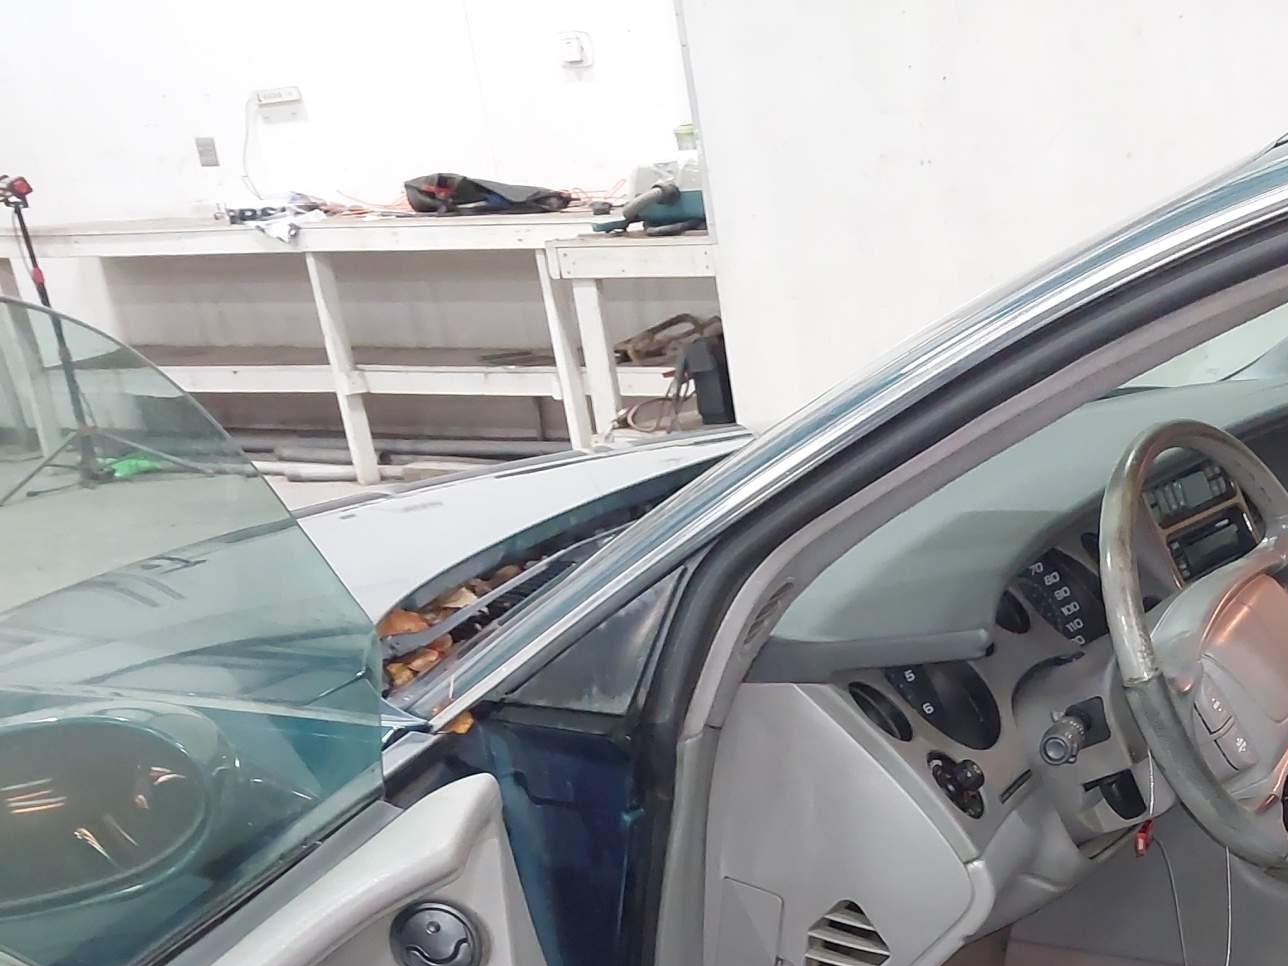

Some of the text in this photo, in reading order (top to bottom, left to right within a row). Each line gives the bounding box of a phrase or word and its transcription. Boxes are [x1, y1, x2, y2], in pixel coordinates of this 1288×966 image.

[1029, 562, 1043, 576] 70
[1044, 571, 1060, 586] 80
[1061, 601, 1080, 616] 100
[1065, 618, 1083, 632] 110
[904, 669, 916, 682] 5
[922, 702, 934, 715] 6
